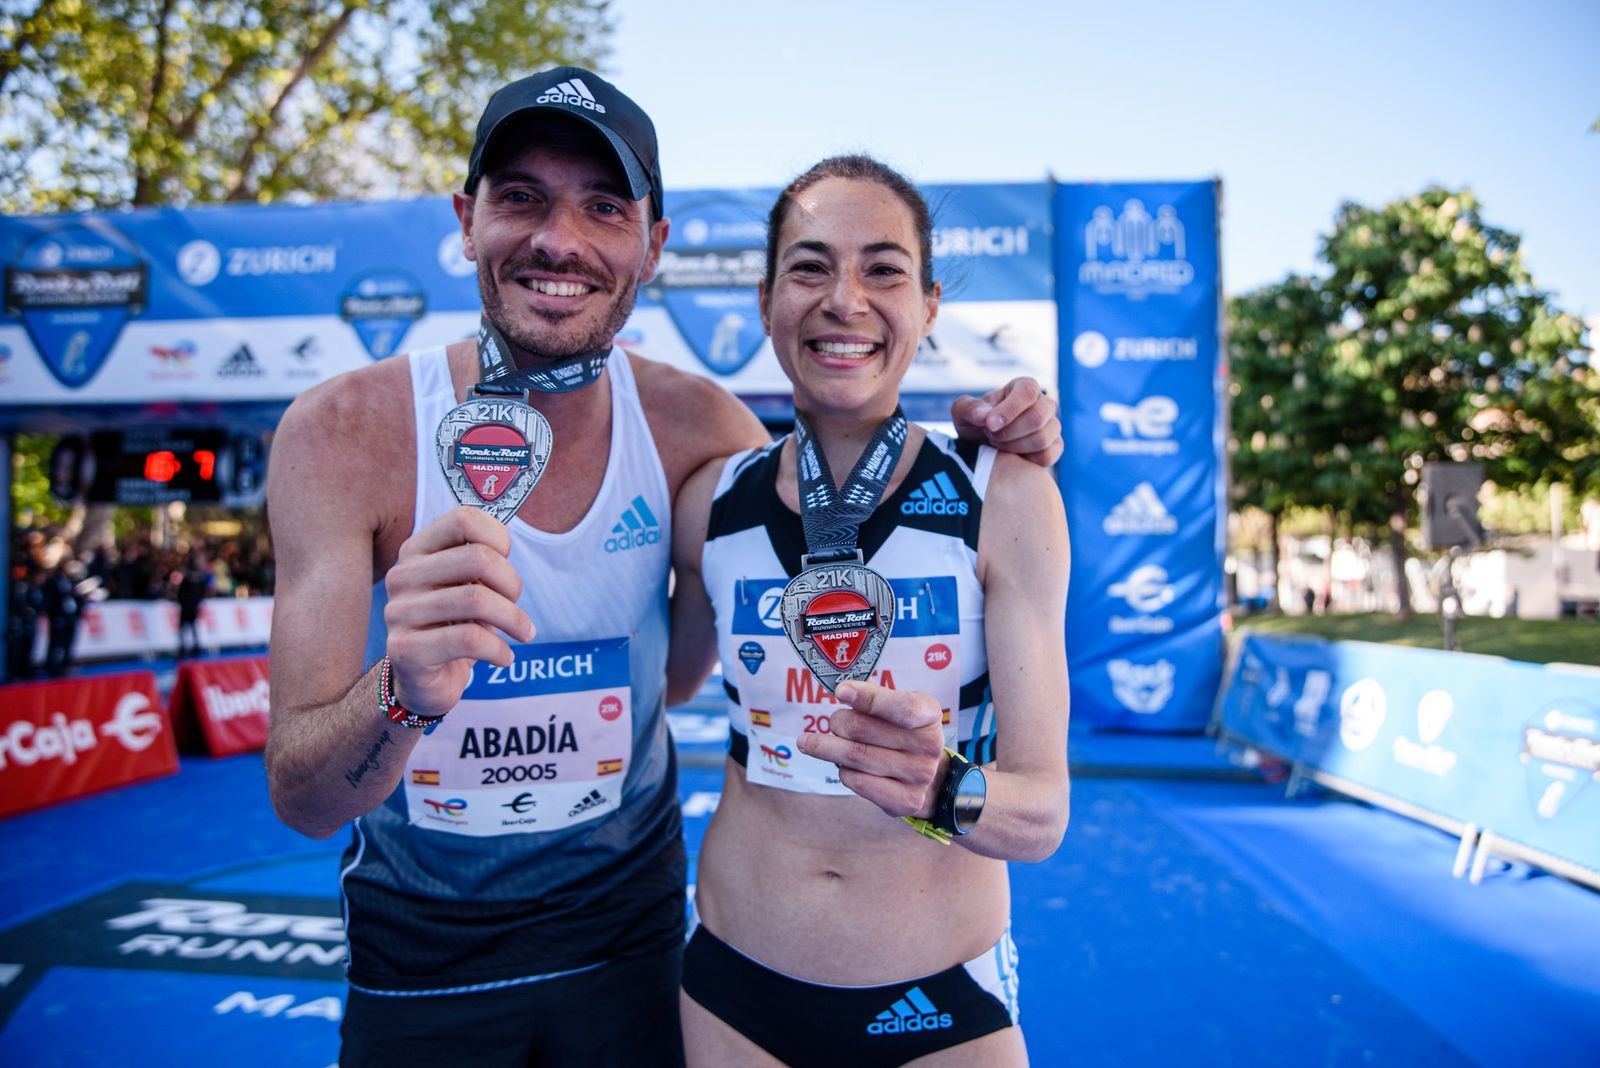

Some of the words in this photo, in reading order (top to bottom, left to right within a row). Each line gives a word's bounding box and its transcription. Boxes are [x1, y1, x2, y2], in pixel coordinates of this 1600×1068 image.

[536, 91, 606, 114] adidas
[931, 225, 1029, 257] URICH
[227, 246, 336, 276] ZURICH
[477, 404, 513, 421] 21K
[472, 464, 511, 472] MADRID
[900, 498, 969, 516] adidas
[816, 569, 852, 589] 21K
[821, 631, 859, 641] MADRID
[487, 654, 593, 684] ZURICH
[927, 653, 947, 663] 21K
[459, 714, 579, 760] ABADÍA
[481, 763, 557, 785] 20005
[866, 1013, 953, 1035] adidas
